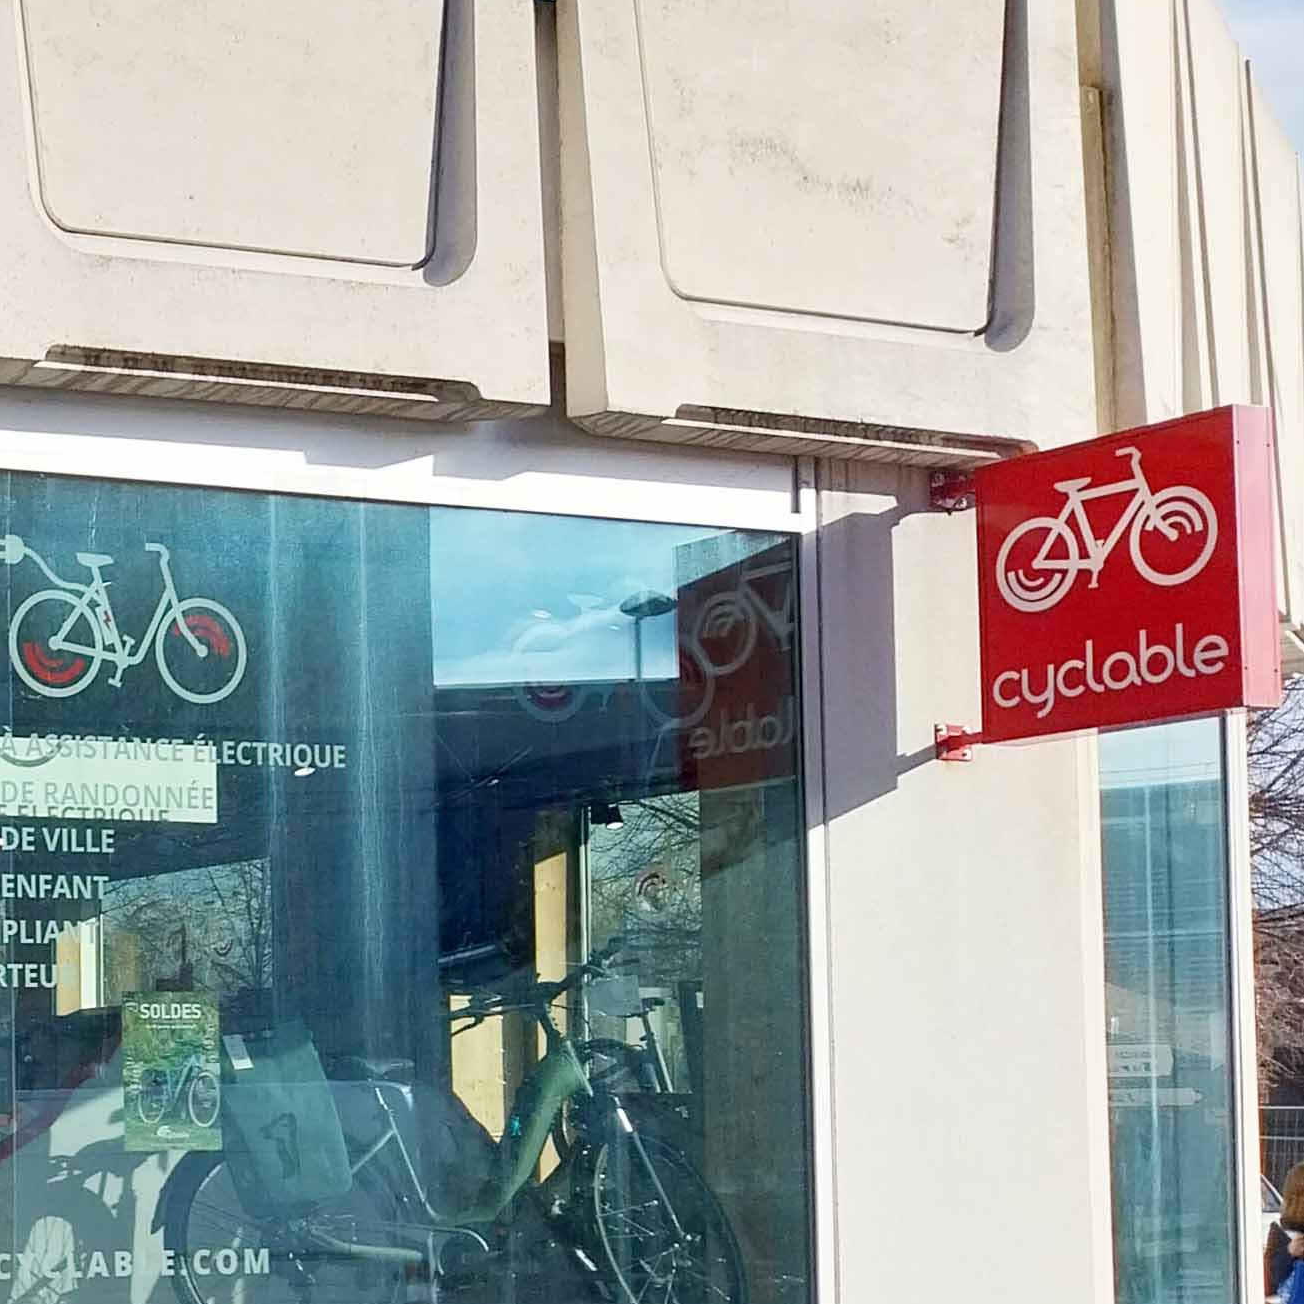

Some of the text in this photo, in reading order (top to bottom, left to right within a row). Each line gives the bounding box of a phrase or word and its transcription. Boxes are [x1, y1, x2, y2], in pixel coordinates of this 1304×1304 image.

[992, 622, 1230, 719] cyclable
[26, 731, 185, 763] ASSISTANCE
[192, 732, 348, 772] ÉLECTRIQUE
[1, 780, 34, 805] DE
[45, 780, 215, 810] RANDONNÉE
[2, 826, 36, 851] DE
[42, 827, 116, 854] VILLE
[2, 874, 109, 900] ENFANT
[140, 1003, 202, 1020] SOLDES
